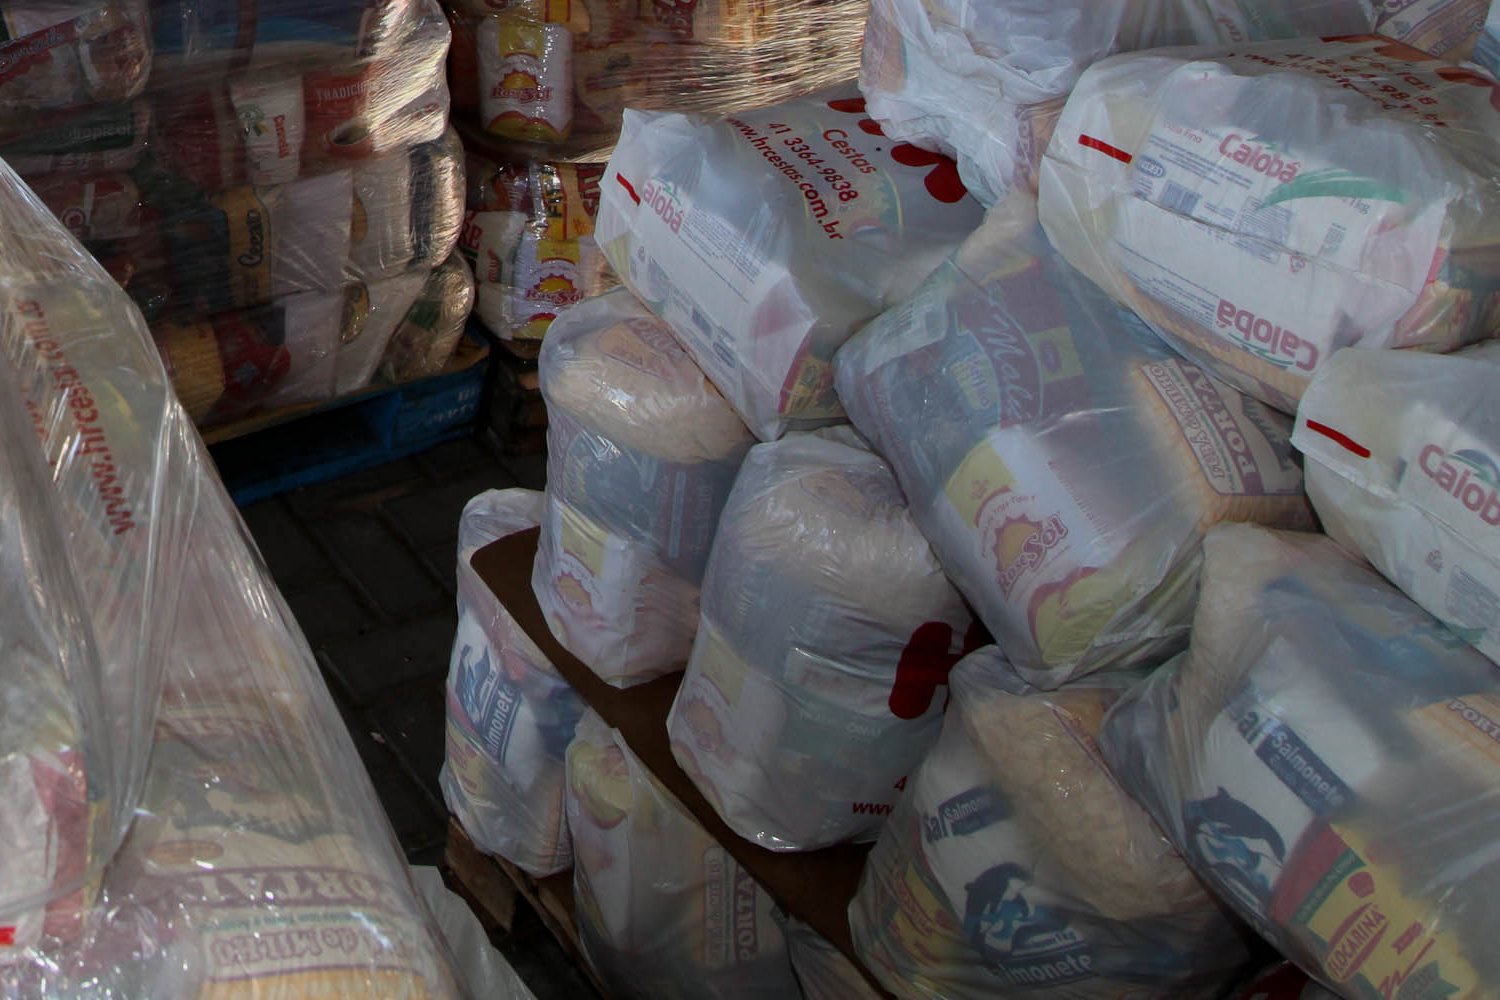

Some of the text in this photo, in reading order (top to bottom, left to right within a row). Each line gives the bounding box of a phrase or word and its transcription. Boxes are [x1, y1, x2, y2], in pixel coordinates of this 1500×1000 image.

[725, 117, 844, 241] www.hrcestas.com.br
[766, 120, 858, 203] 41 3364-9838
[822, 128, 877, 175] Cestas
[1418, 443, 1500, 526] Caiob
